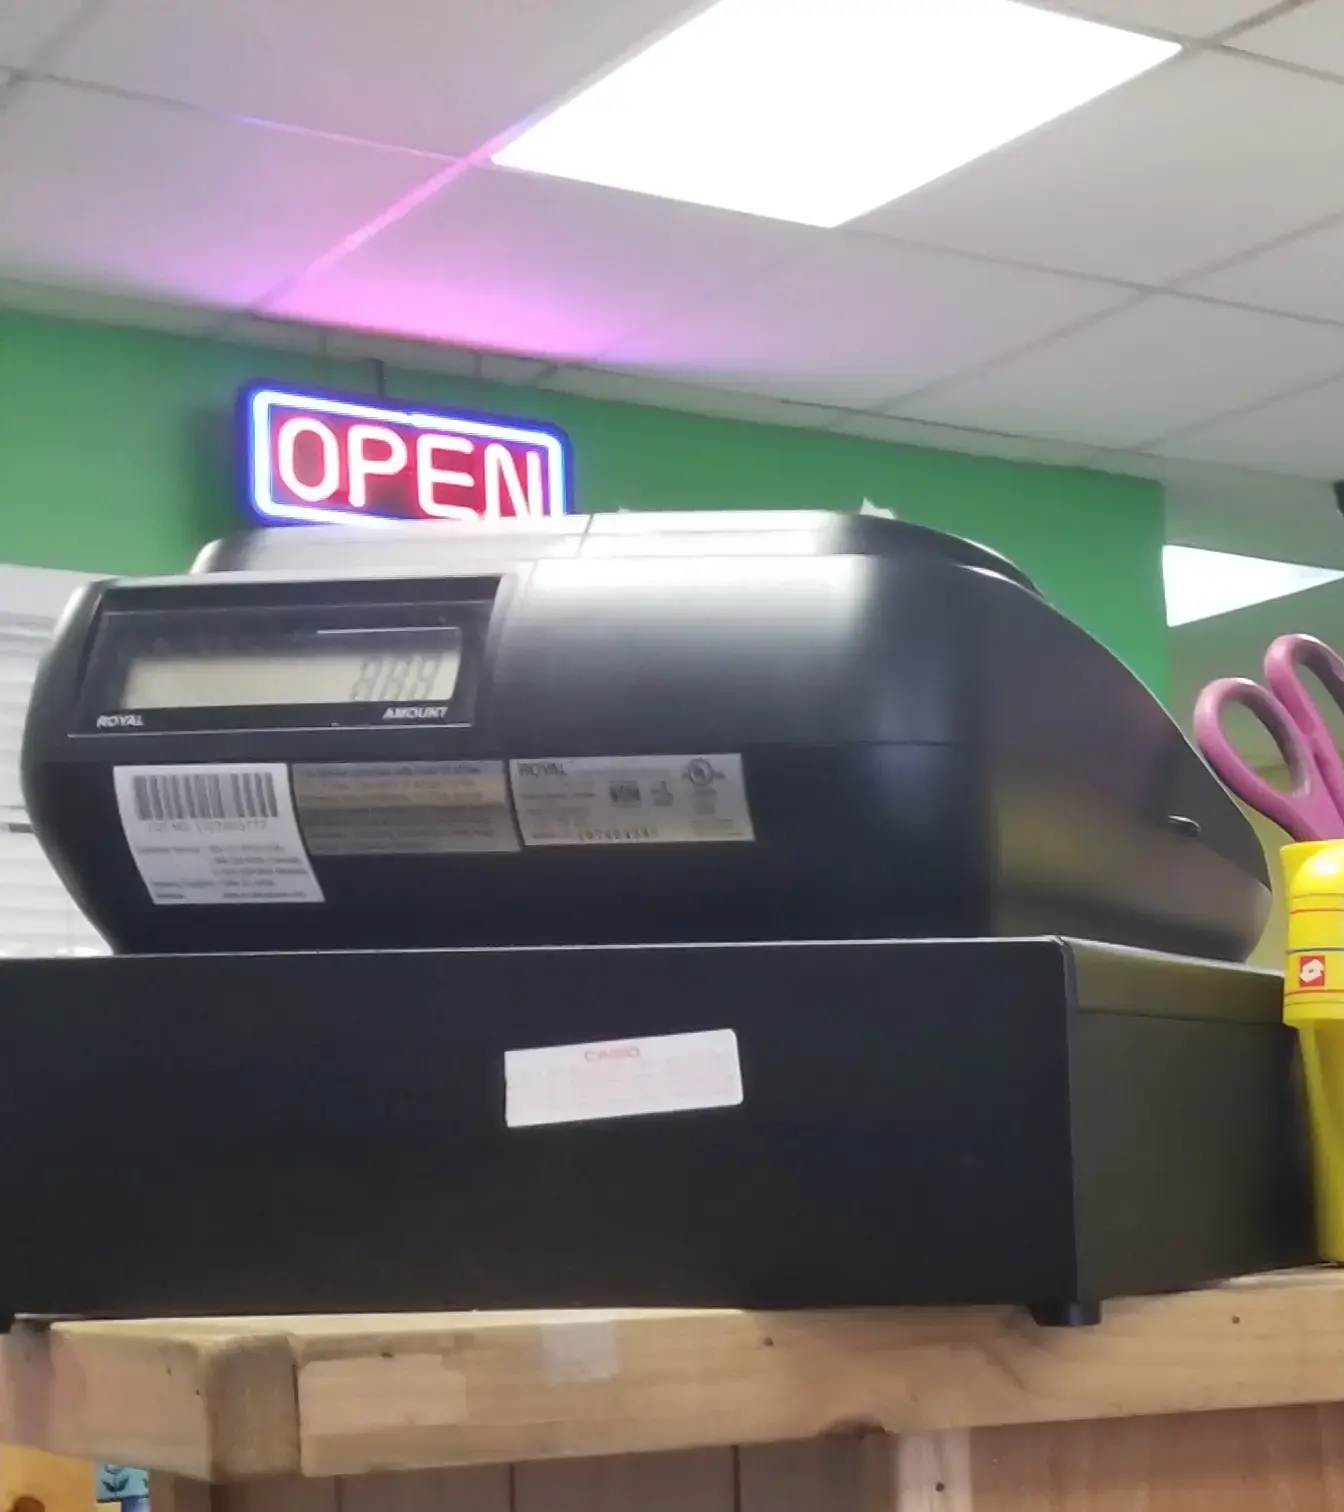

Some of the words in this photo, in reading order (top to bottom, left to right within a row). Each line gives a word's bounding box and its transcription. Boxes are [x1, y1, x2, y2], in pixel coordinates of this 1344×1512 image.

[277, 416, 542, 521] OPEN
[382, 706, 449, 720] AMOUNT
[96, 714, 145, 728] ROYAL
